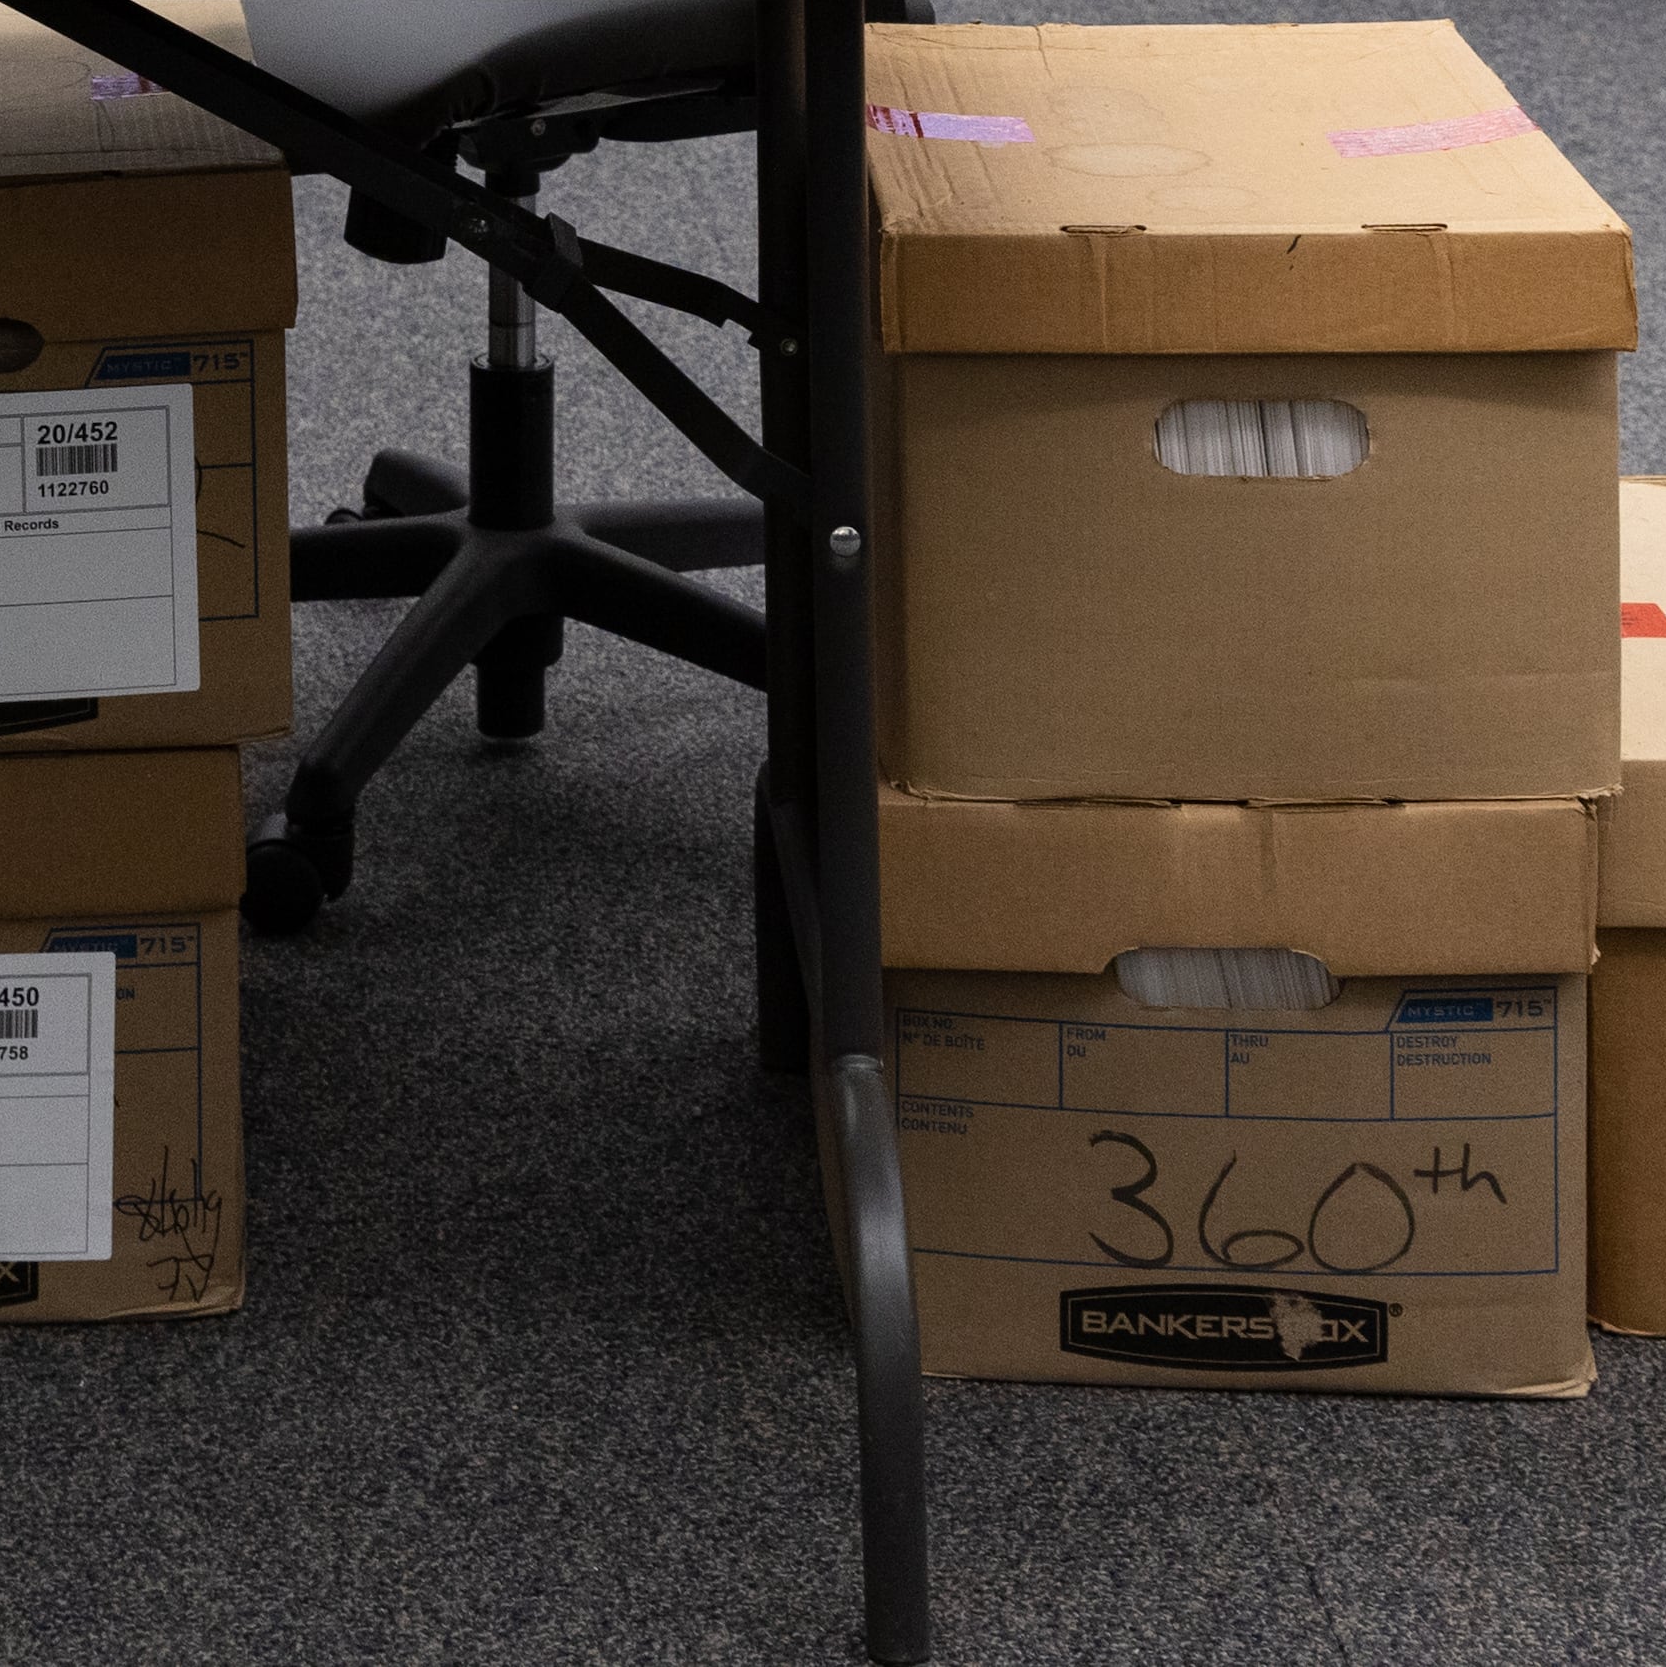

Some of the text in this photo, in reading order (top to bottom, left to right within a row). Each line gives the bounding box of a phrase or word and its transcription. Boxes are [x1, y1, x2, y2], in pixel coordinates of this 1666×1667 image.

[37, 421, 118, 445] 20/452
[38, 479, 110, 498] 1122760
[4, 518, 59, 532] Records
[1407, 1005, 1475, 1017] MYSTIC
[902, 1014, 930, 1027] BOX
[923, 1033, 941, 1046] DE
[1066, 1027, 1106, 1041] FROM
[1230, 1034, 1269, 1047] THRU
[1397, 1035, 1458, 1048] DESTROY
[1066, 1045, 1085, 1057] DU
[1230, 1052, 1250, 1064] AU
[1397, 1052, 1492, 1066] DESTRUCTION
[902, 1100, 974, 1118] CONTENTS
[902, 1118, 968, 1135] CONTENU
[1081, 1310, 1275, 1341] BANKERS
